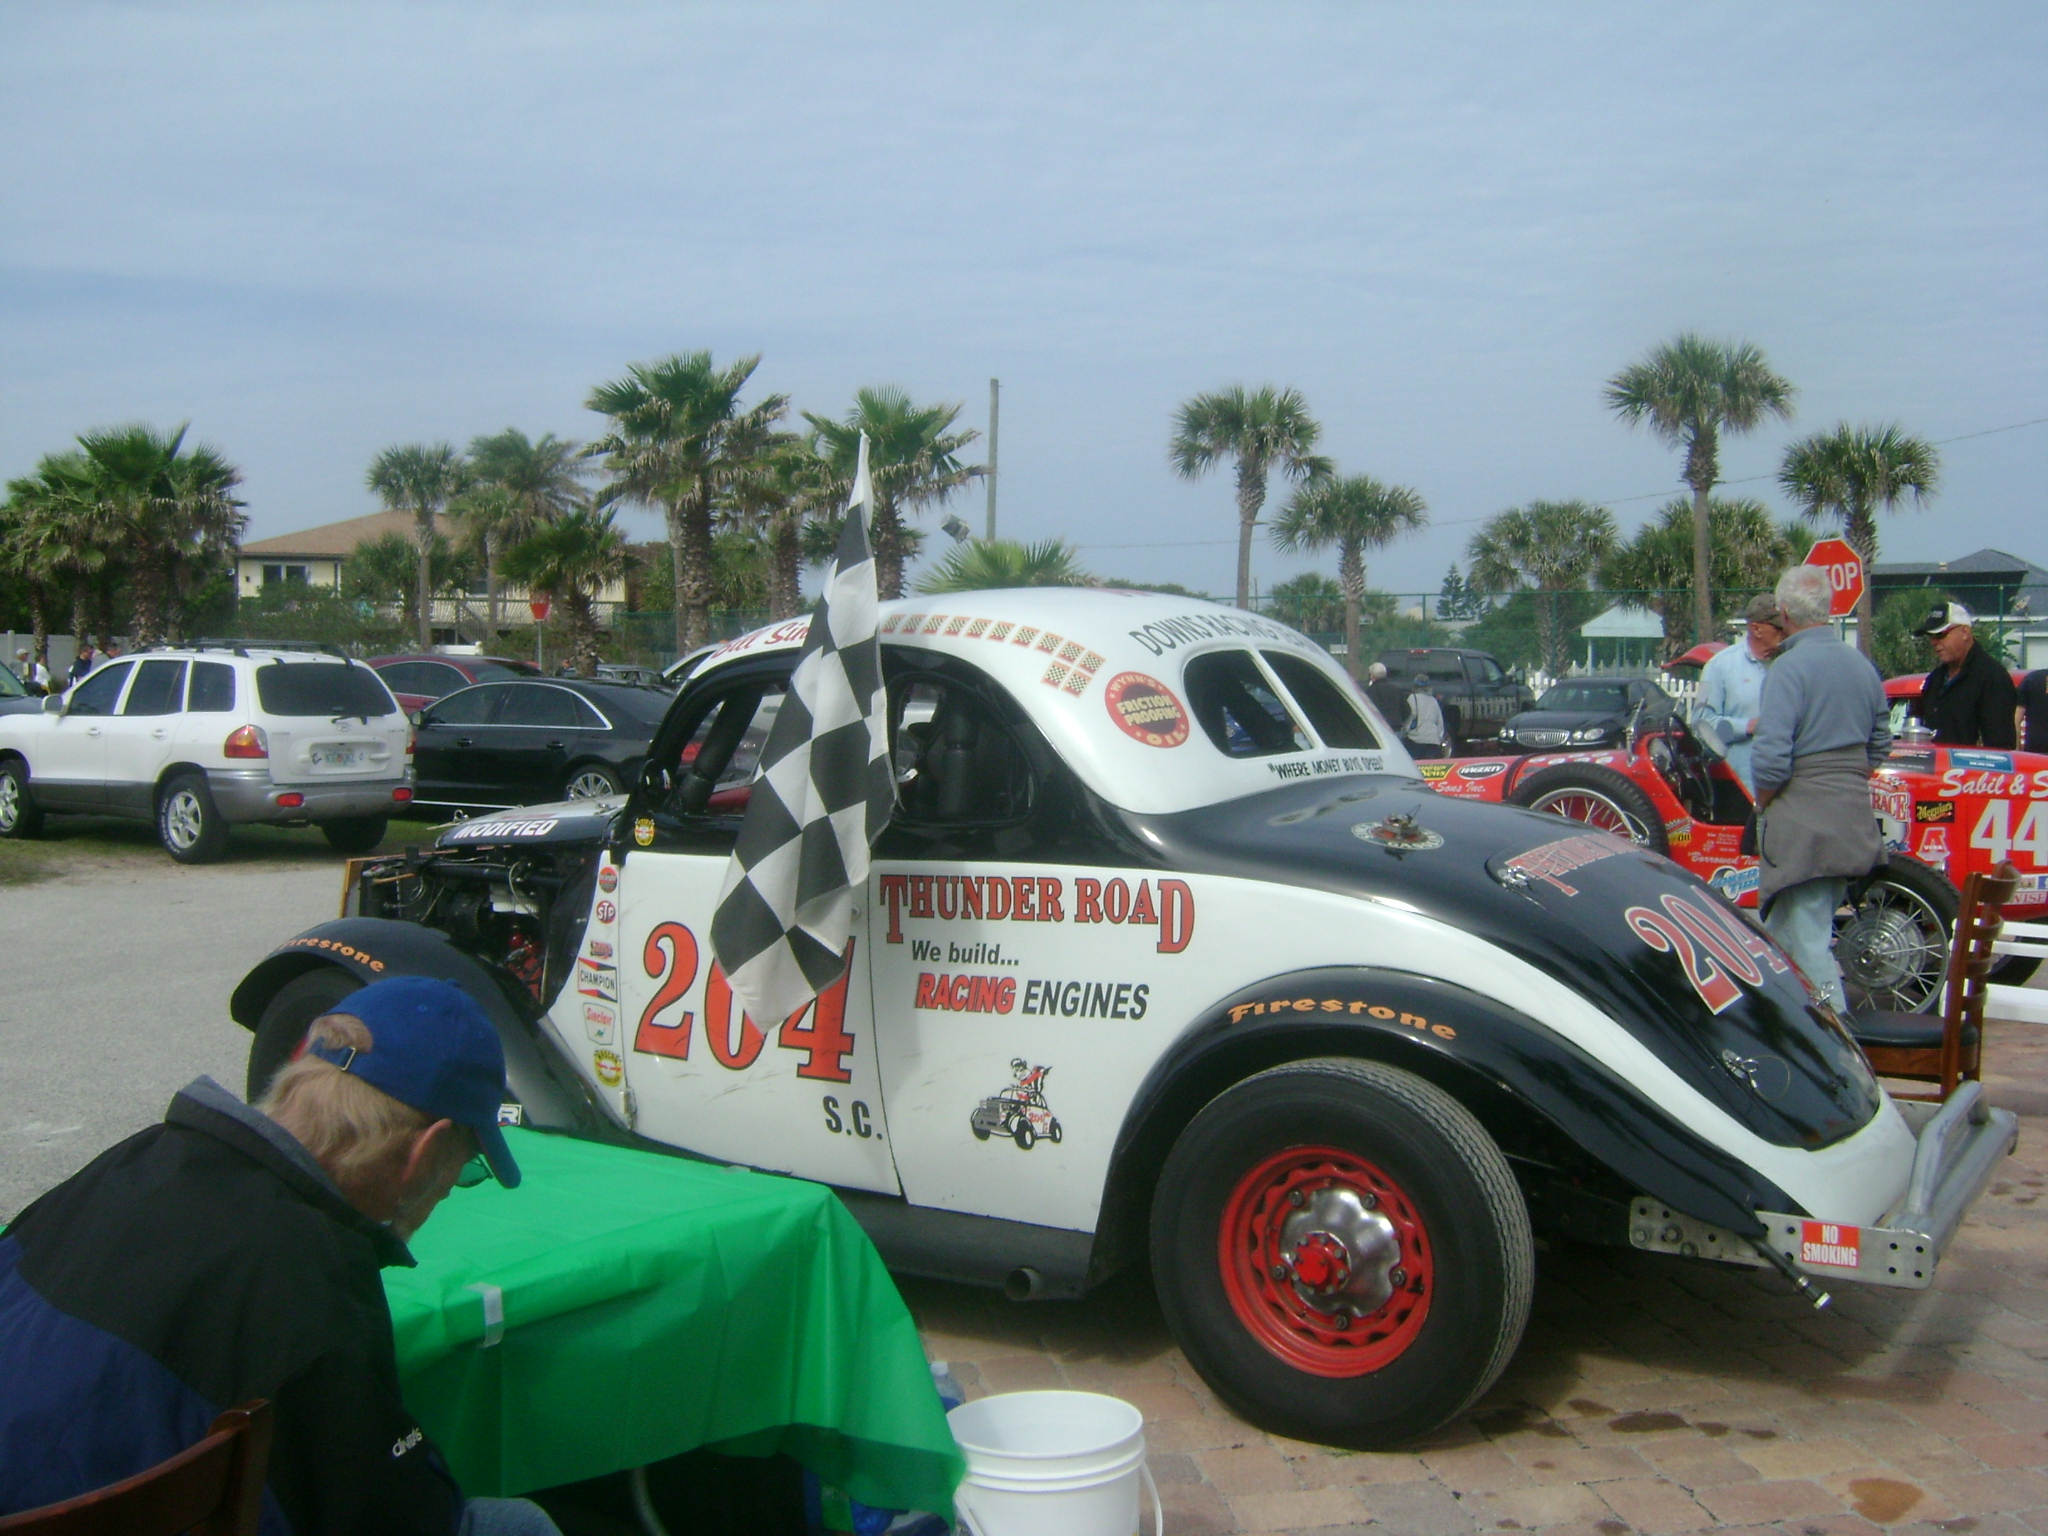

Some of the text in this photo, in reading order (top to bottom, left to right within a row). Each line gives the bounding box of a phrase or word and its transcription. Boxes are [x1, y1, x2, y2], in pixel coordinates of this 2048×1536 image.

[1128, 614, 1214, 657] DOWNS
[1116, 694, 1174, 715] FRICTION
[1123, 706, 1182, 727] PROOFING
[1146, 730, 1186, 746] OIL
[1311, 758, 1340, 775] MONEY
[1460, 765, 1504, 774] HAGERTY
[1938, 768, 2006, 797] Sabil
[2008, 773, 2026, 796] &
[453, 819, 559, 840] MODIFIED
[597, 902, 616, 921] STP
[880, 874, 1196, 954] THUNDER ROAD
[911, 940, 1020, 967] We build...
[1624, 884, 1788, 1016] 204
[580, 970, 616, 990] CHAMPION
[633, 921, 856, 1084] 204
[915, 972, 1150, 1021] RACING ENGINES
[1227, 998, 1458, 1041] Firestone
[823, 1095, 884, 1141] S.C.
[1821, 1224, 1839, 1244] NO
[1803, 1241, 1858, 1267] SMOKING
